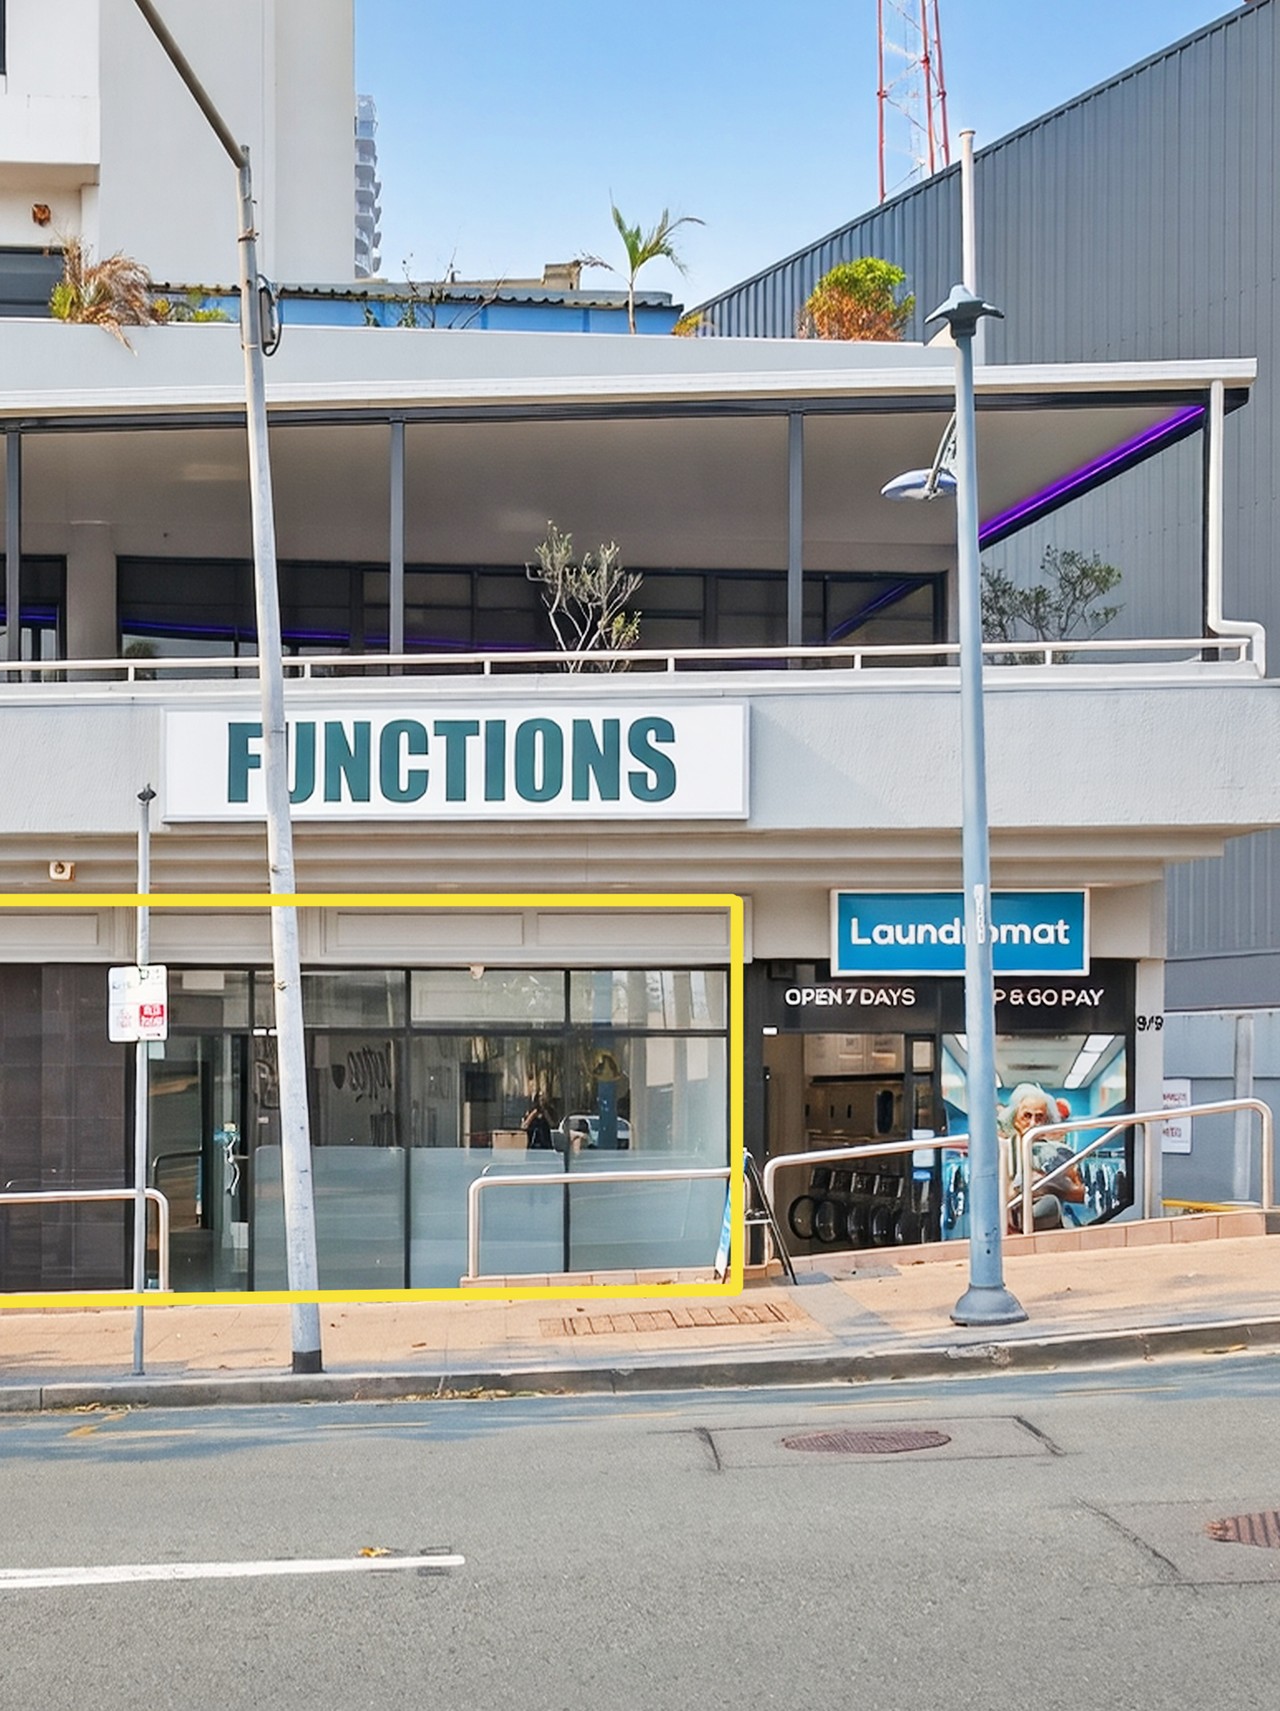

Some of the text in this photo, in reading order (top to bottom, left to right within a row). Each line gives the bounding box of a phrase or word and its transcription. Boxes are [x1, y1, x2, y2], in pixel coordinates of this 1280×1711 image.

[227, 716, 677, 803] FUNCTIONS
[850, 917, 1071, 946] Laundmat
[785, 988, 916, 1006] OPEN 7 DAYS
[1009, 988, 1024, 1005] &
[1026, 988, 1059, 1006] GO
[1061, 988, 1105, 1006] PAY
